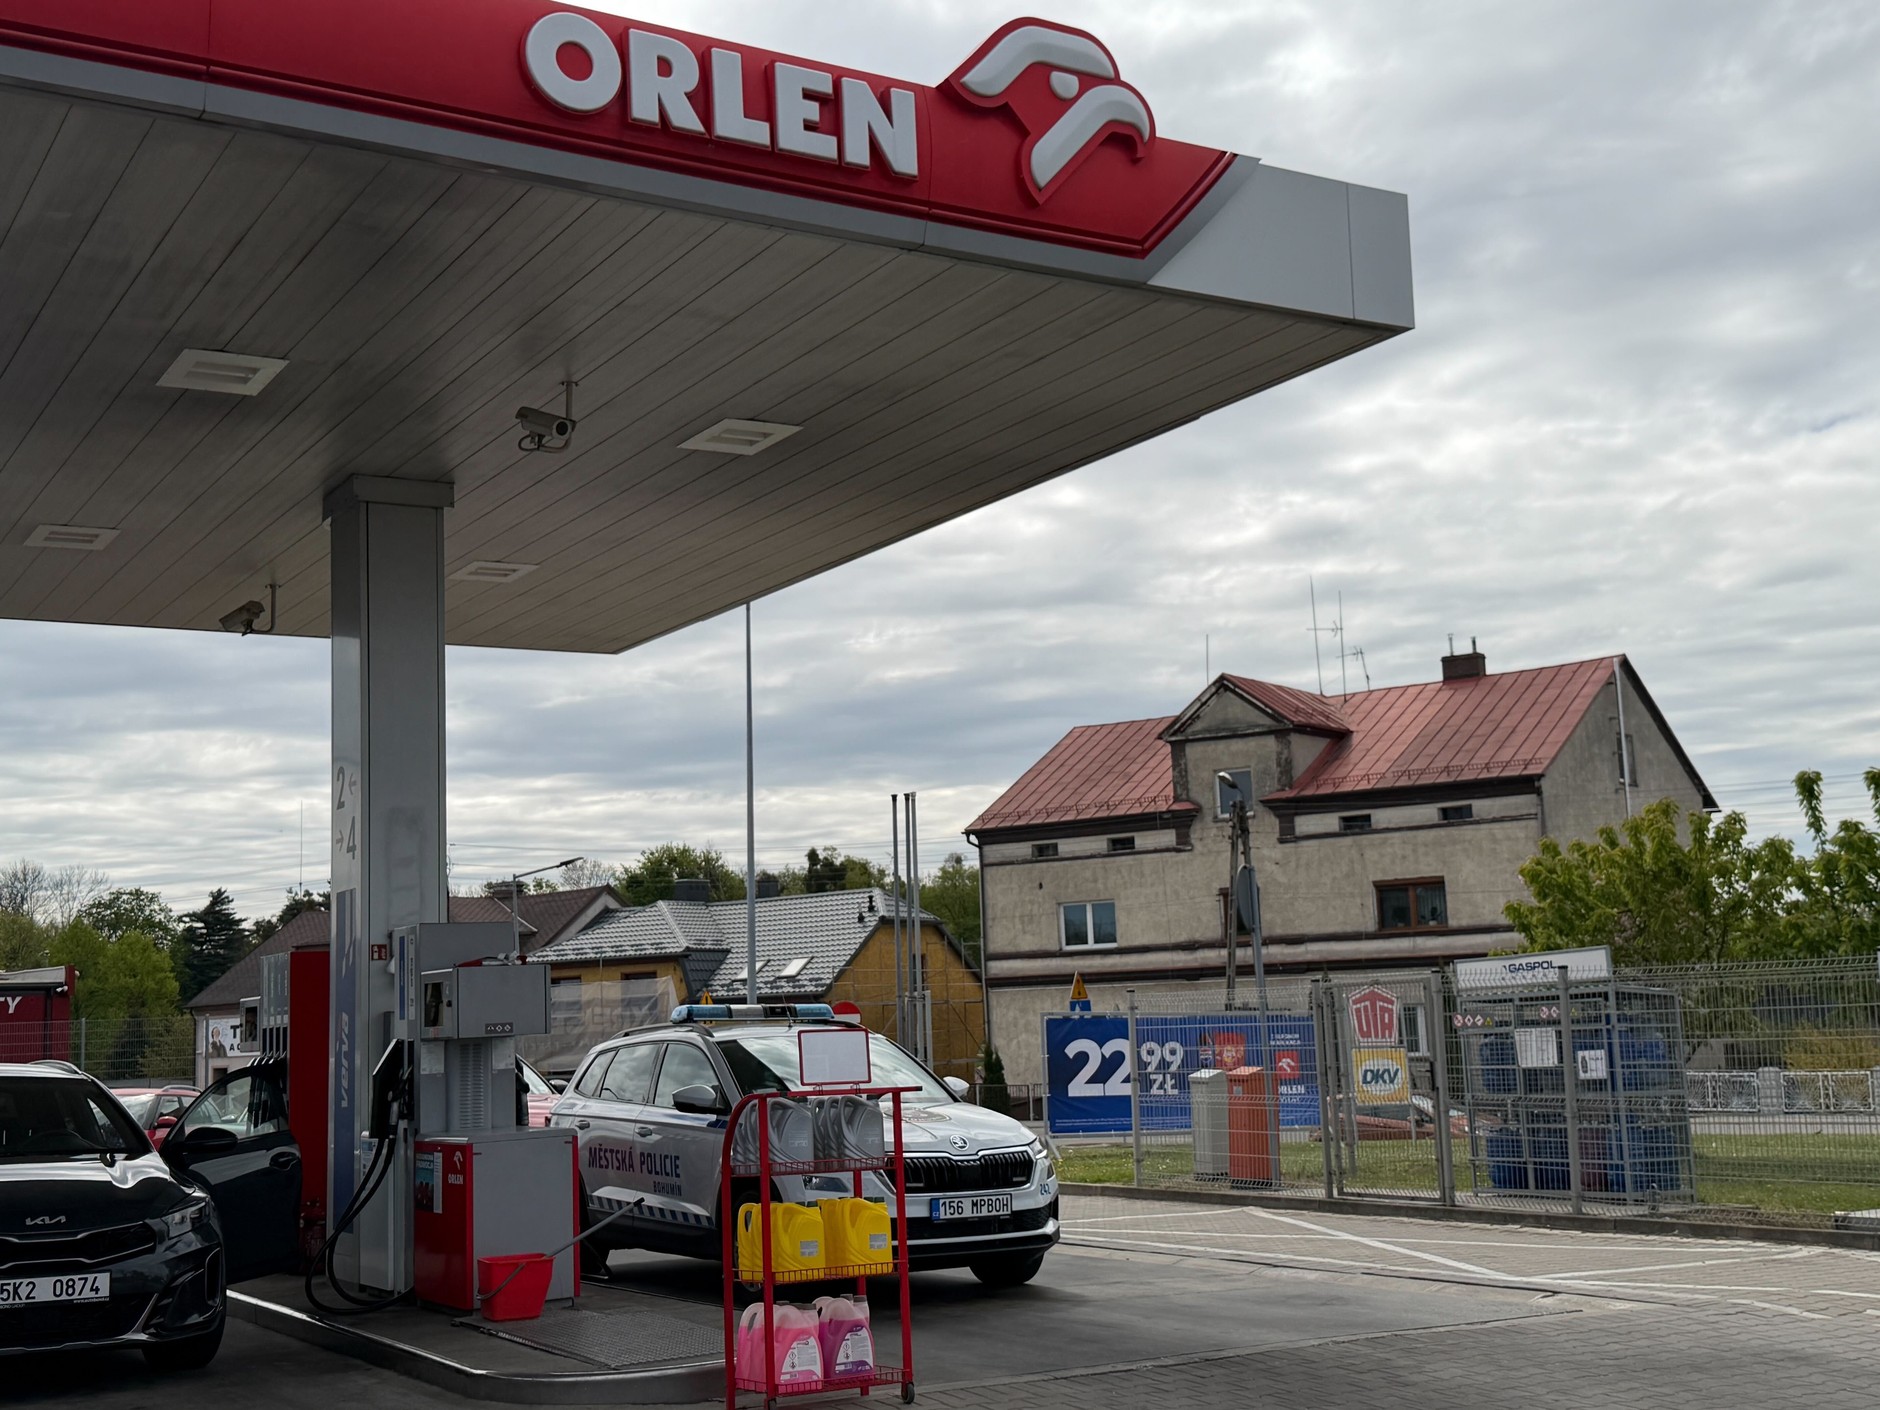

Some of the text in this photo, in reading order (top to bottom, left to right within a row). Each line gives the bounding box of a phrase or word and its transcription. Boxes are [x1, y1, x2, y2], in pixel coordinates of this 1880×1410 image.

[525, 11, 919, 178] ORLEN
[336, 766, 346, 810] 2
[346, 815, 357, 860] 4
[1508, 960, 1558, 973] GASPOL
[0, 996, 23, 1014] Y
[1352, 988, 1396, 1040] UTA
[1064, 1038, 1184, 1097] 22 99
[1361, 1068, 1400, 1085] DKV
[589, 1143, 681, 1178] MĚSTSKÁ POLICIE
[448, 1173, 464, 1185] ORLEN
[653, 1180, 682, 1197] BOHUMÍN
[1040, 1183, 1052, 1196] 242
[941, 1200, 964, 1216] 156
[971, 1197, 1010, 1215] MPBOH
[0, 1276, 101, 1302] 5K2 0874
